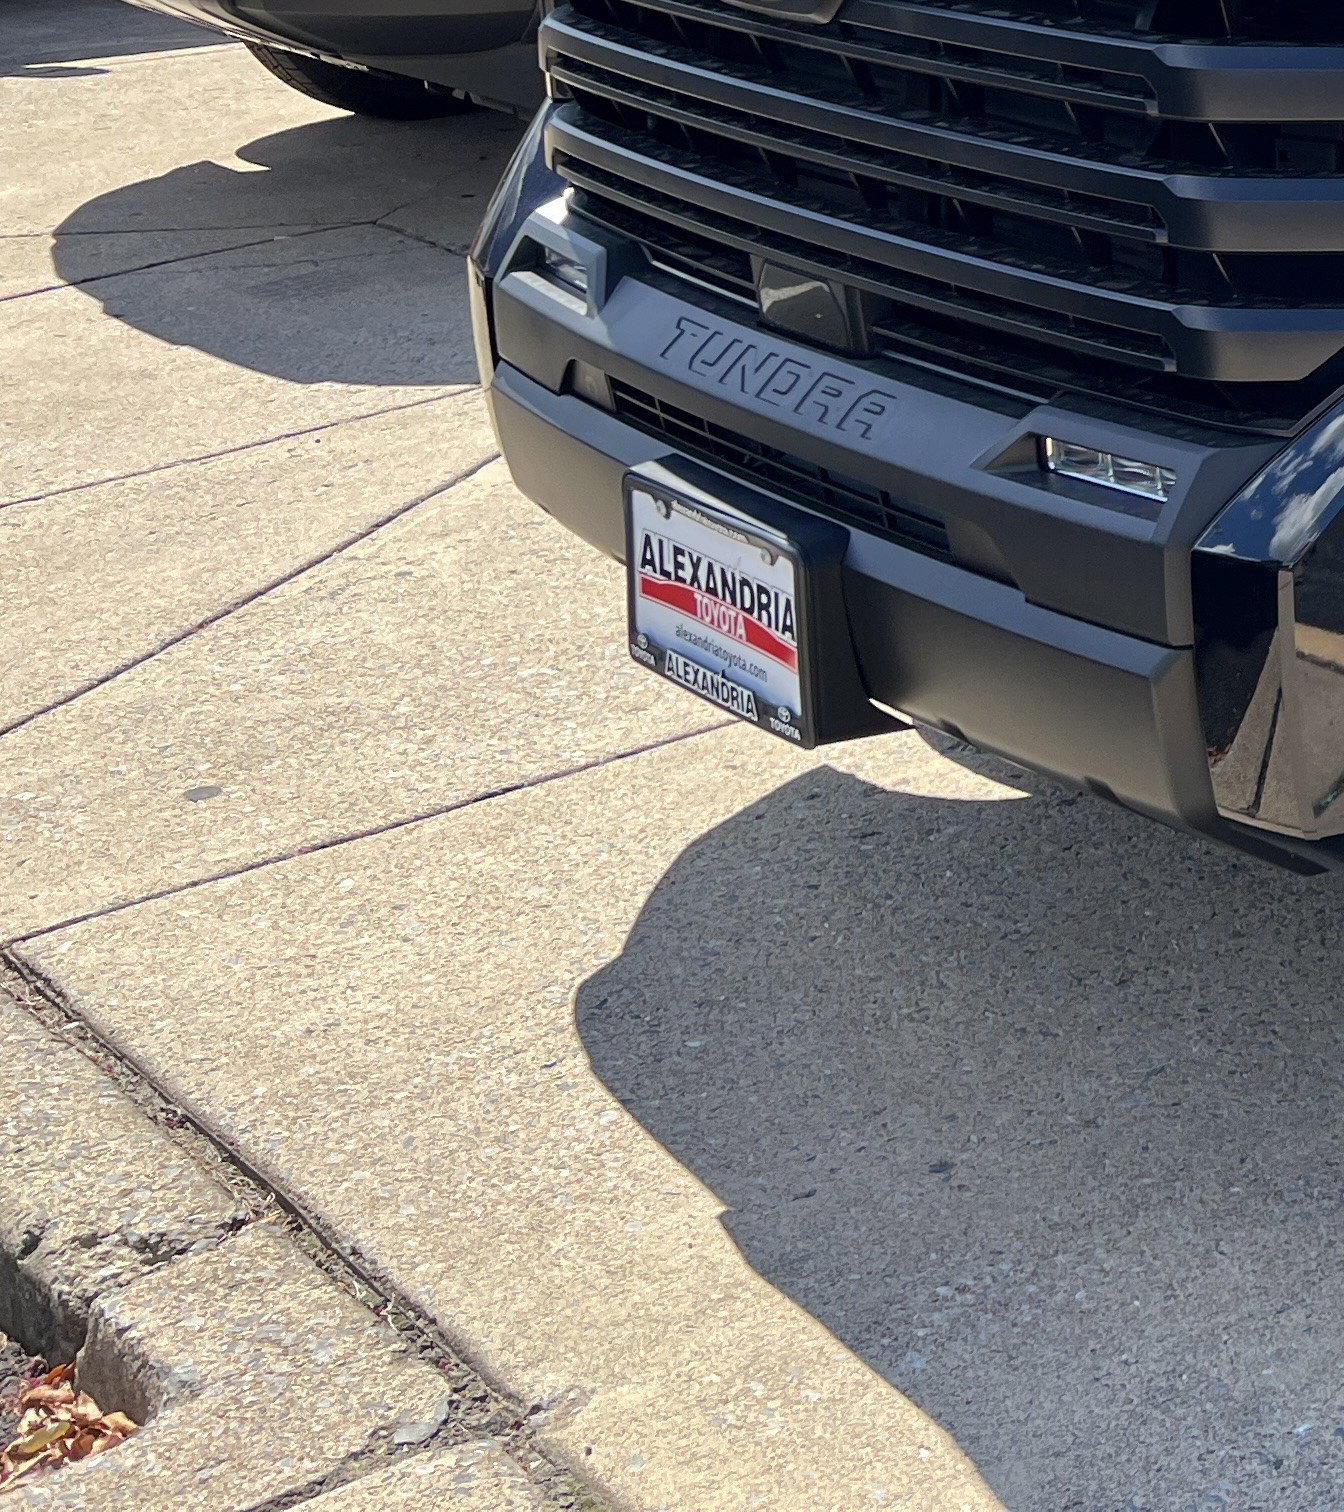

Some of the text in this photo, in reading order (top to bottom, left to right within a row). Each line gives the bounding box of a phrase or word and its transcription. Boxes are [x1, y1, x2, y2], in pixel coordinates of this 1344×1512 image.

[659, 316, 899, 441] TUNDRA
[640, 533, 797, 641] ALEXANDRIA
[693, 591, 748, 642] TOYOTA
[665, 652, 757, 720] ALEXANDRIA
[675, 624, 768, 683] alexandriatoyota.com
